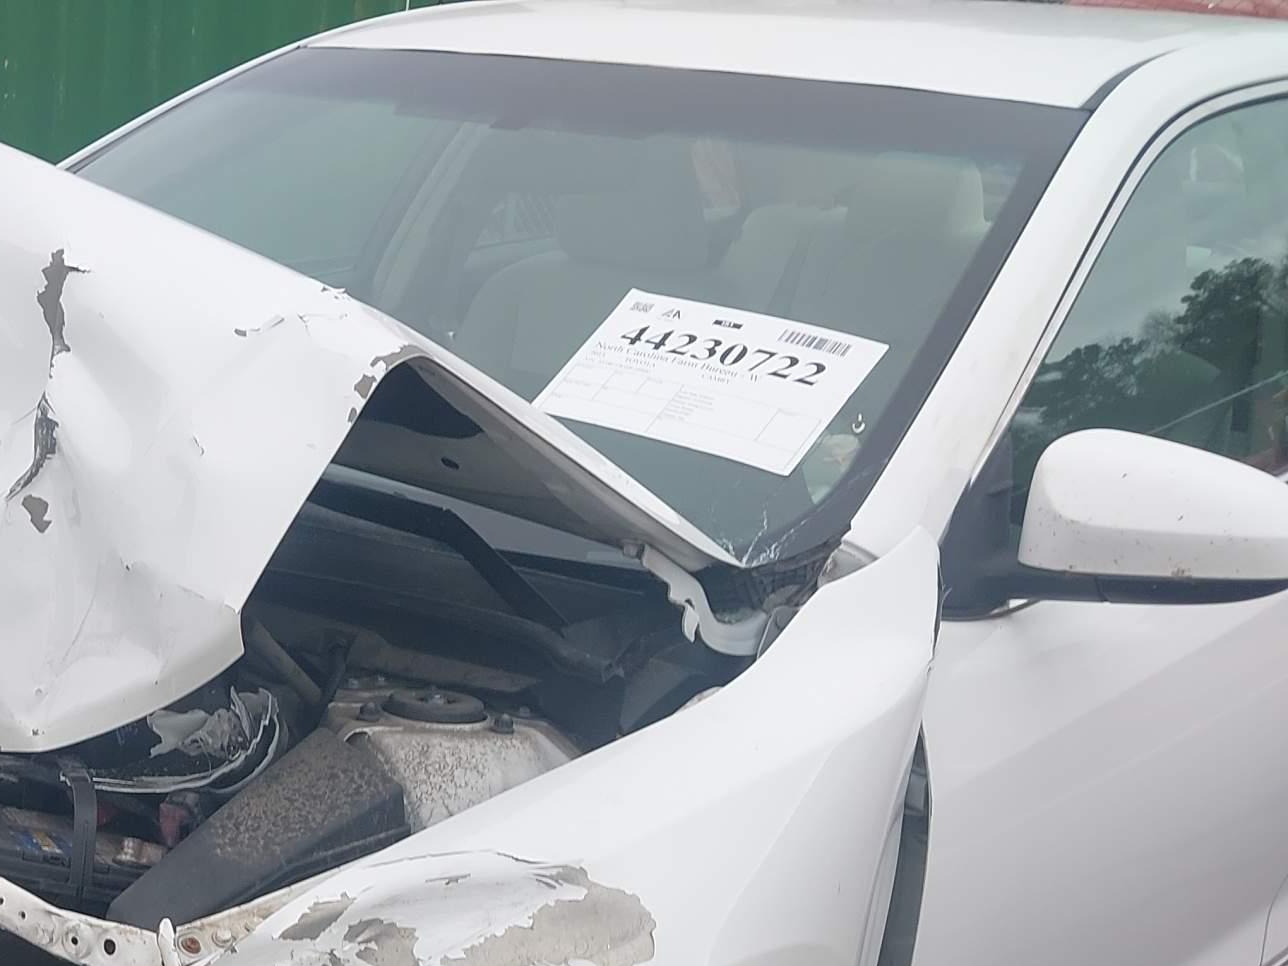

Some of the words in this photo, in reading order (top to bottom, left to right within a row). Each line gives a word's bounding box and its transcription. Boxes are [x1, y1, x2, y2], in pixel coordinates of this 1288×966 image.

[596, 340, 624, 354] North
[626, 346, 669, 363] Carolina
[671, 356, 698, 369] Farm
[700, 362, 738, 378] Bureau
[619, 324, 827, 387] 44230722
[623, 357, 657, 368] TOYOTA
